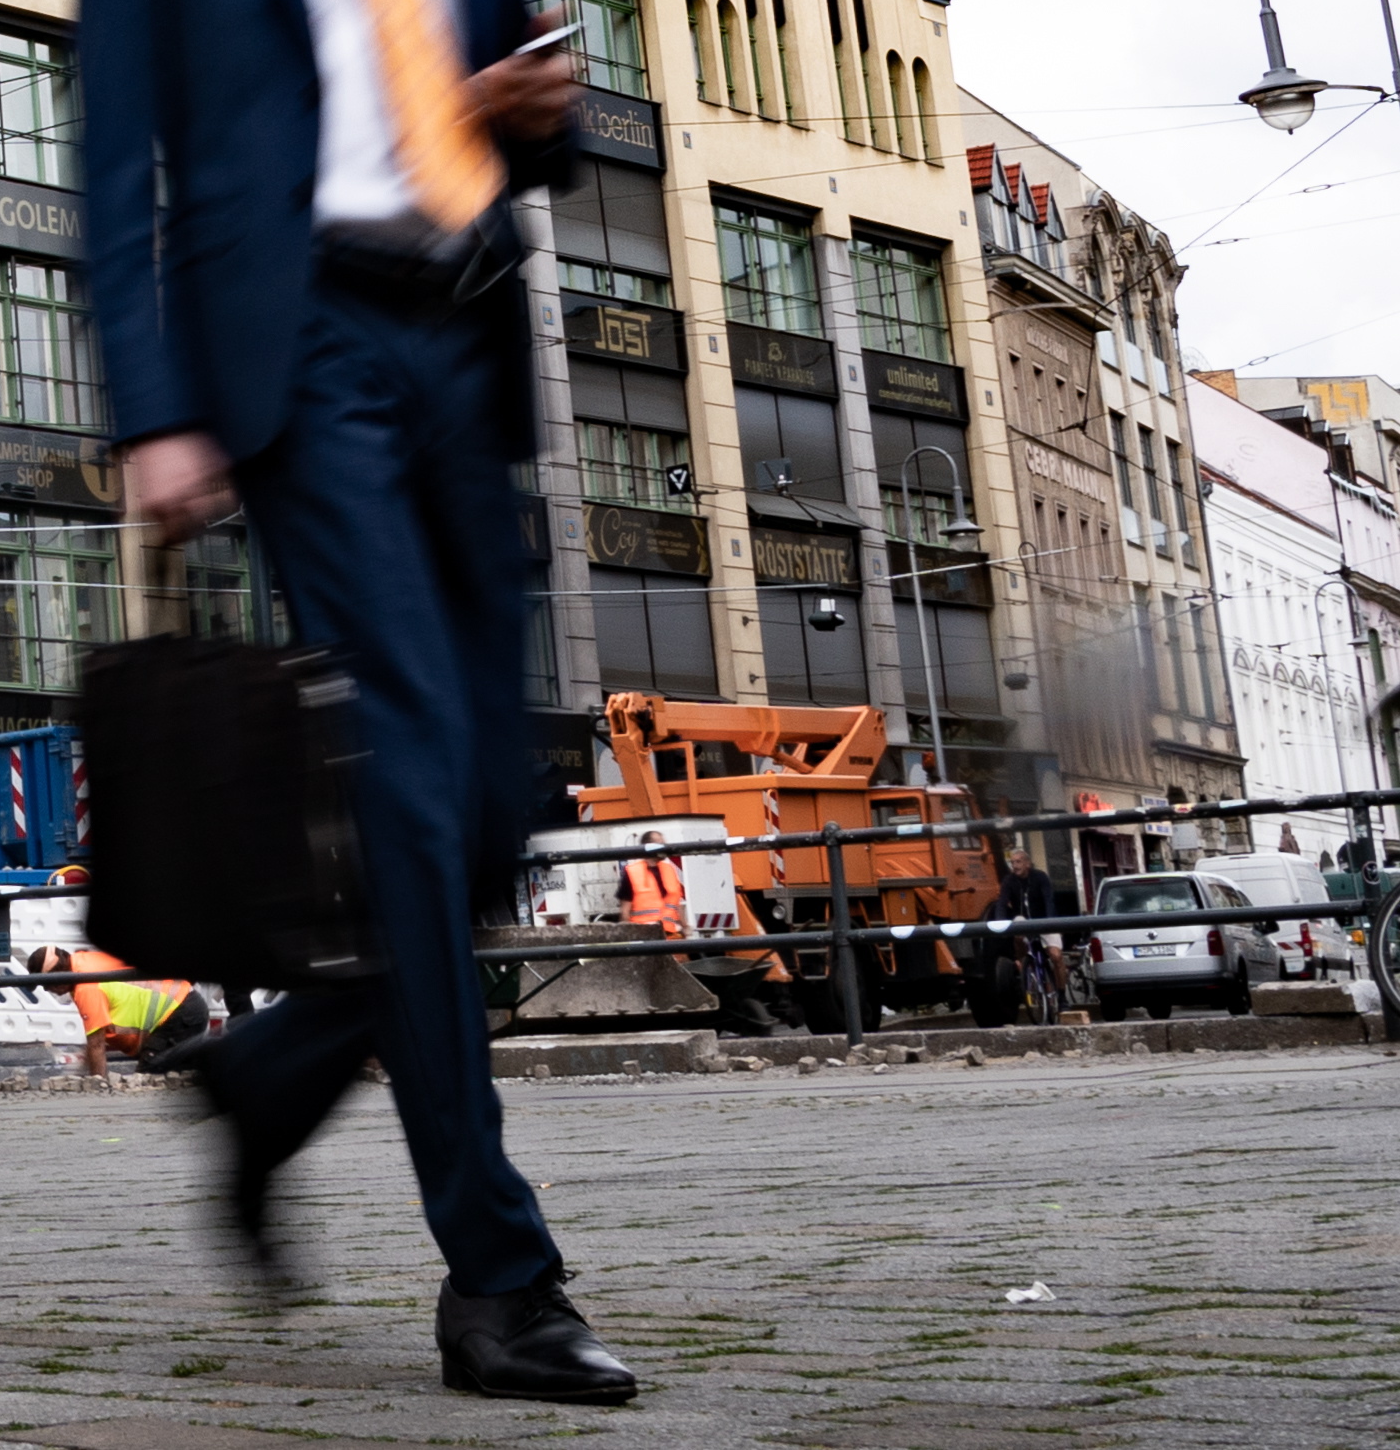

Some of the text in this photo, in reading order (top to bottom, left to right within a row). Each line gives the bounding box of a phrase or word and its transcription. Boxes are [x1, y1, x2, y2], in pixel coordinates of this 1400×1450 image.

[0, 196, 82, 239] GOLEM
[887, 366, 939, 393] unlimited
[16, 465, 55, 489] SHOP
[753, 533, 850, 585] RÖSTSTÄTTE
[547, 745, 583, 767] HÖFE
